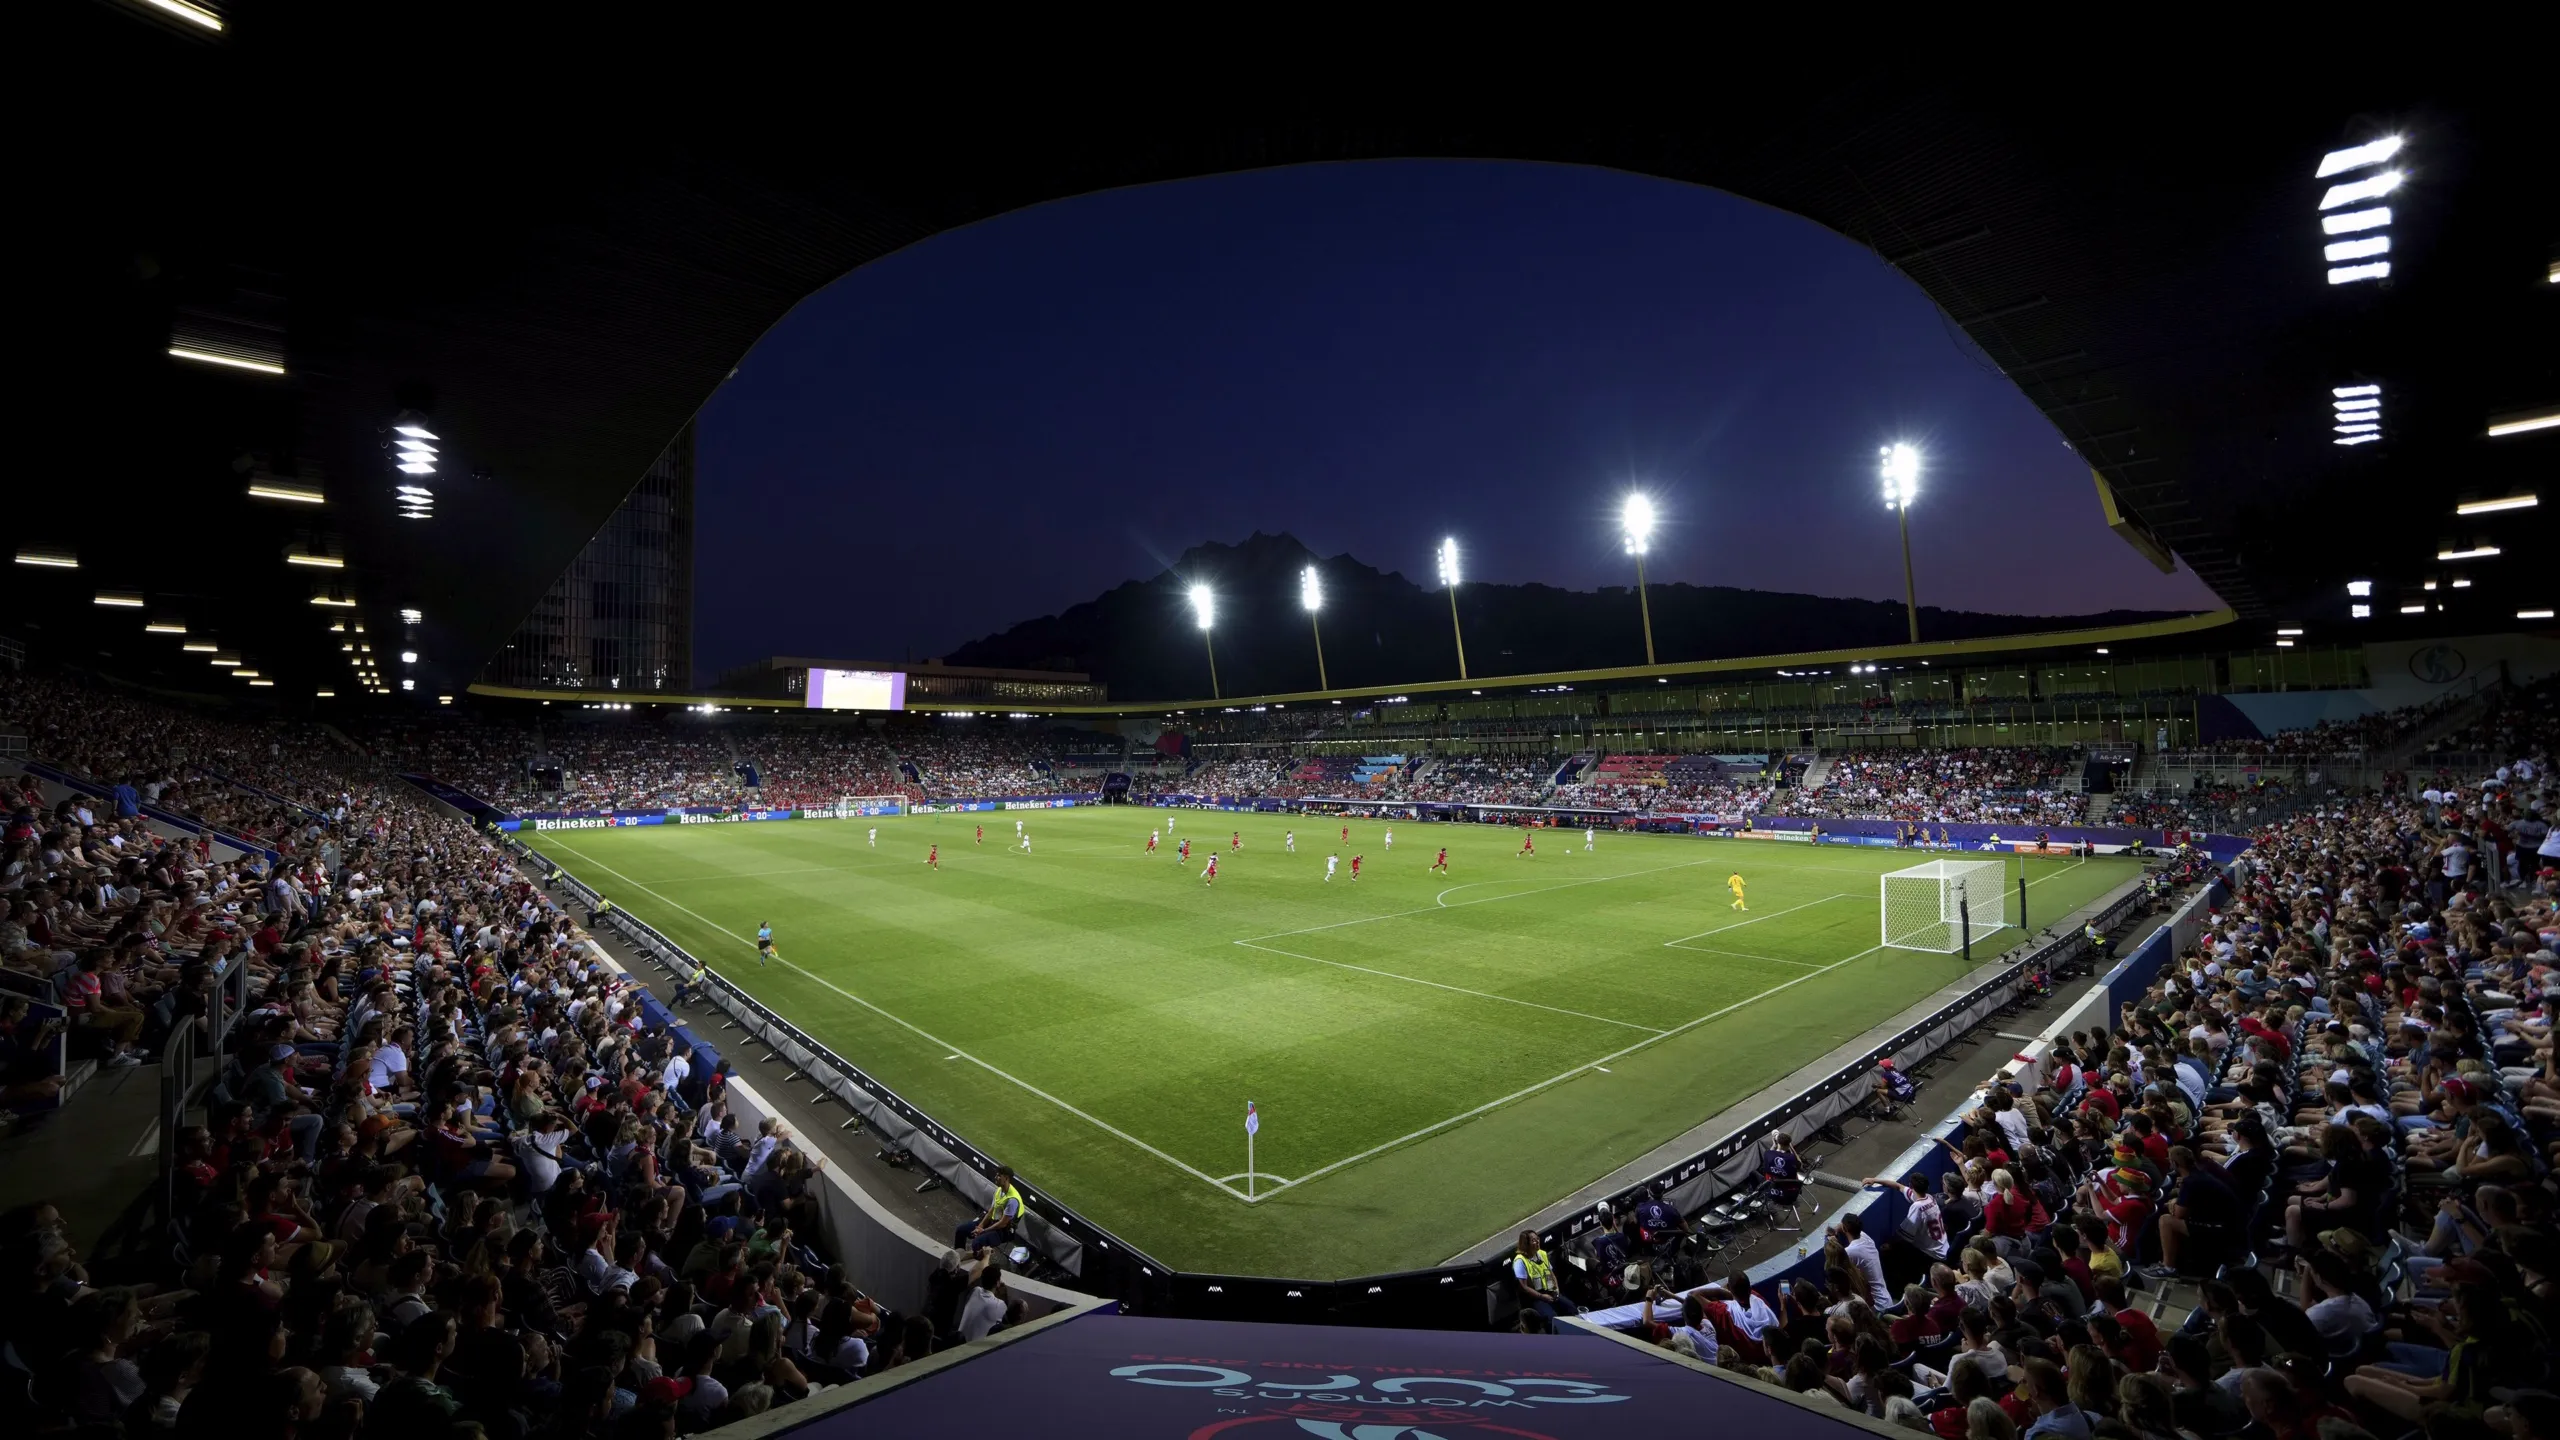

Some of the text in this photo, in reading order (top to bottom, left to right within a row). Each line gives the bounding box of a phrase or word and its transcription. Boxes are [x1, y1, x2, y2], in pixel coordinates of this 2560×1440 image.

[1005, 800, 1045, 809] Heineken
[537, 818, 606, 830] Heineken
[1774, 833, 1808, 842] Heineken
[1978, 843, 1996, 851] AXA
[1131, 1354, 1590, 1378] SWITZERLAND 2025
